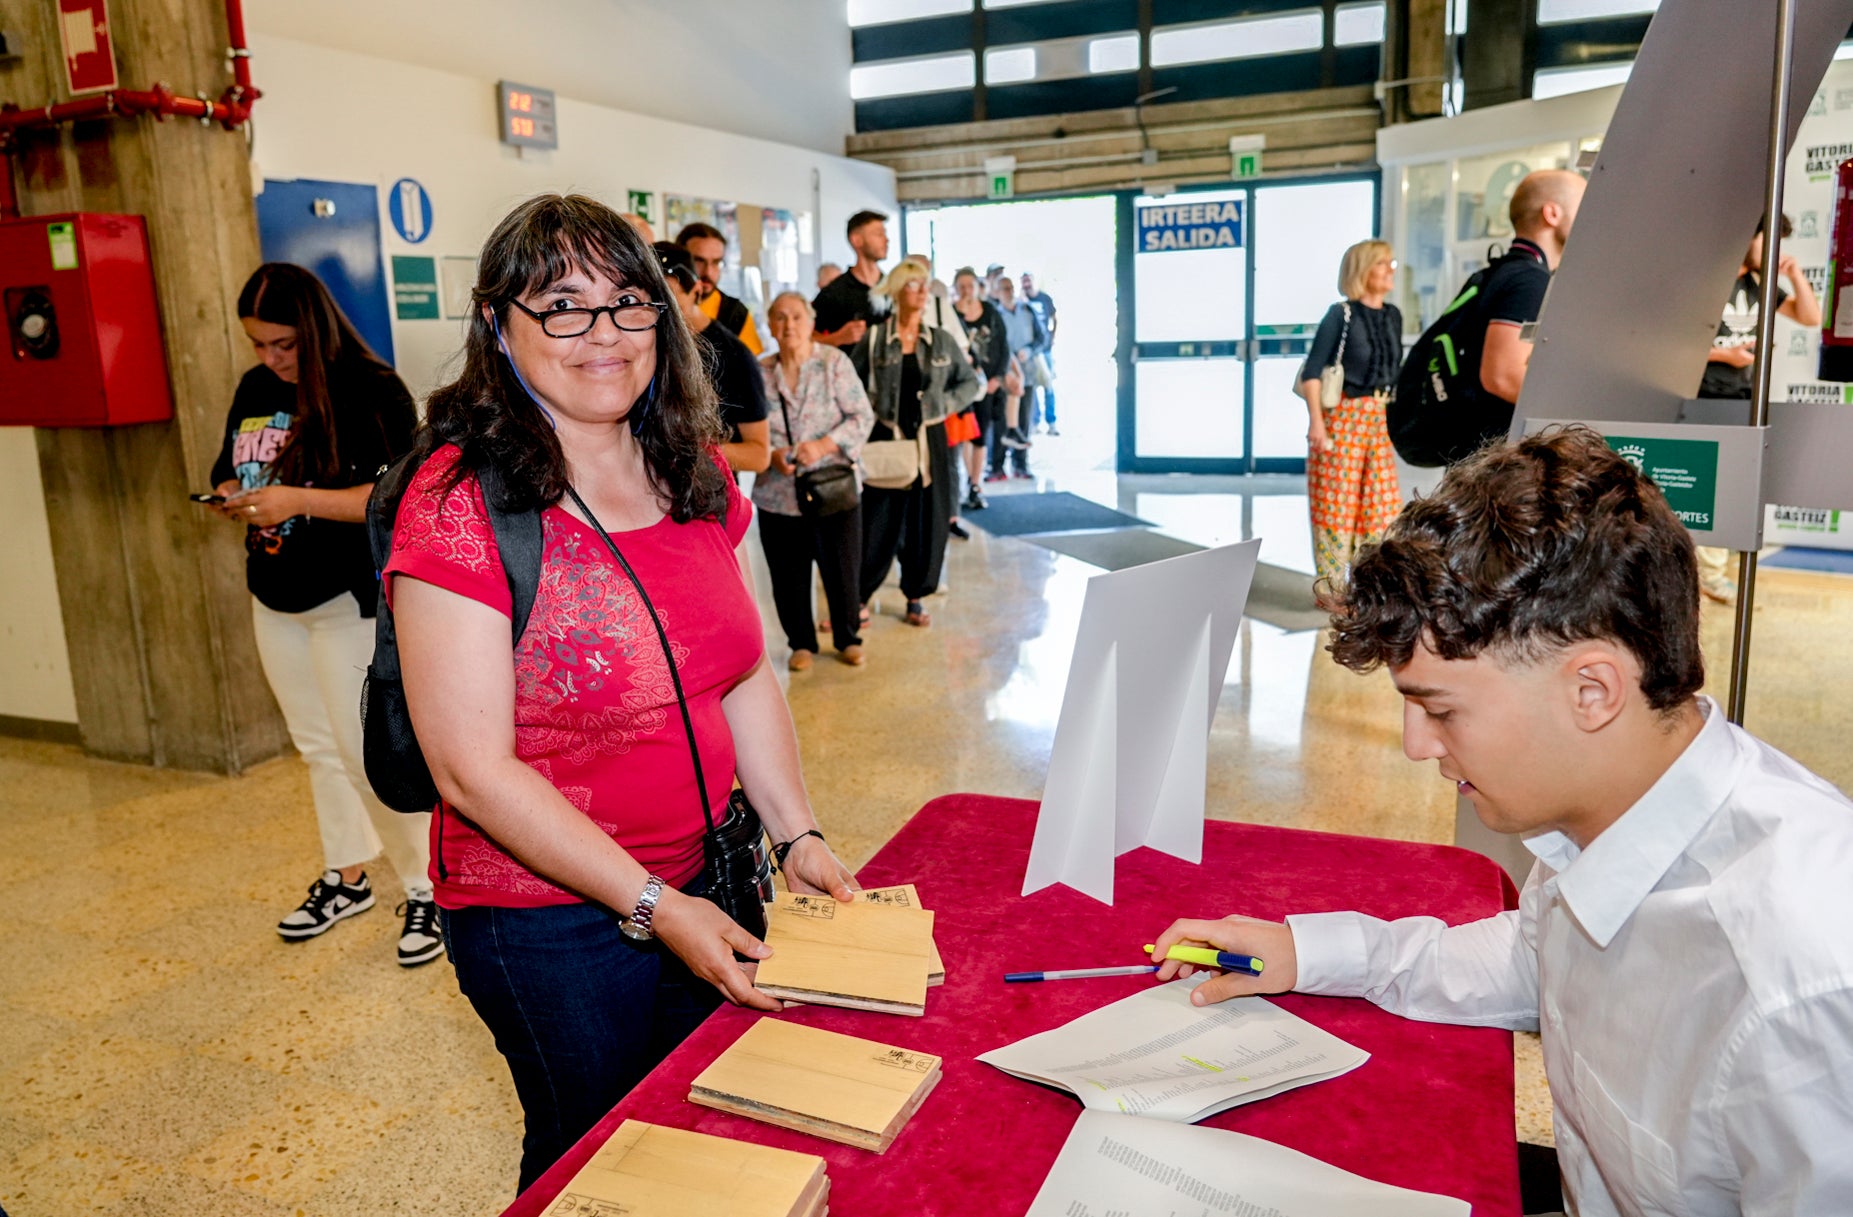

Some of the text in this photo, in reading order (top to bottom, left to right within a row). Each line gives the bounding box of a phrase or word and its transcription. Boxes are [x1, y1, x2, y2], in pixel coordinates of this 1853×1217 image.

[1806, 143, 1853, 158] VITORI
[1141, 202, 1240, 228] IRTEERA
[1145, 226, 1236, 250] SALIDA
[1787, 384, 1841, 397] VITORIA
[1675, 510, 1709, 523] ORTES
